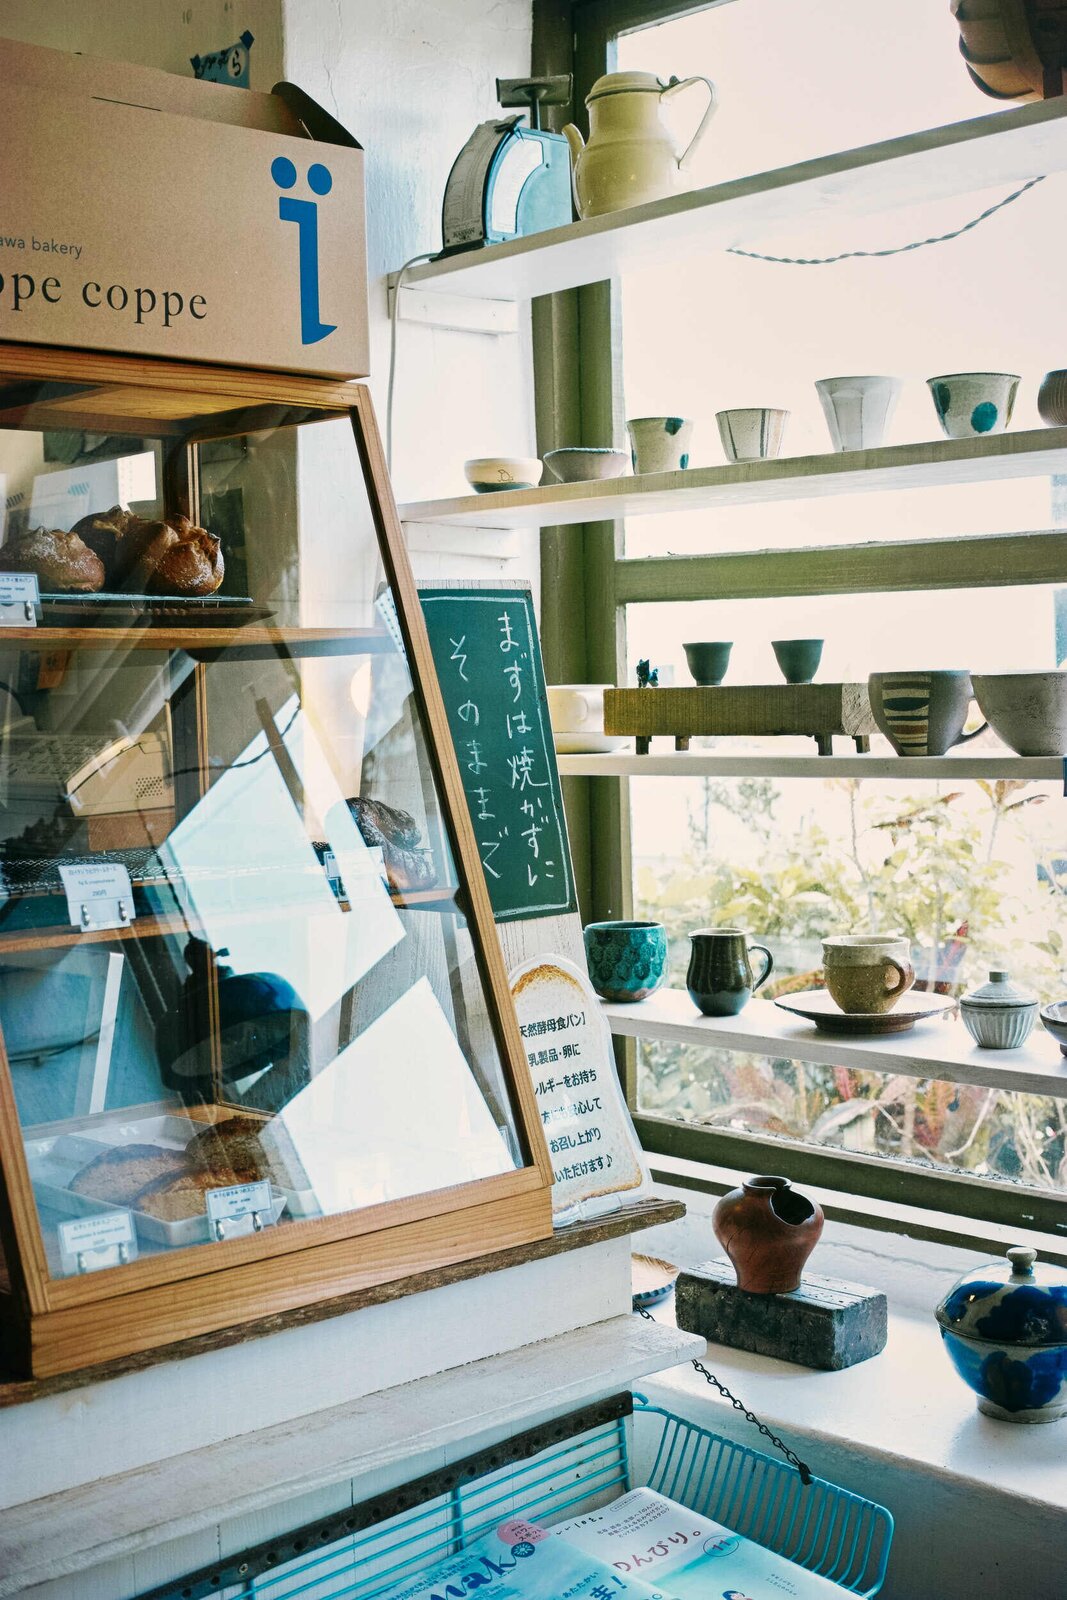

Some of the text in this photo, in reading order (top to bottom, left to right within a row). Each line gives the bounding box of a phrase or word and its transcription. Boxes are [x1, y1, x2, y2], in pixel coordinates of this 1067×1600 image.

[32, 235, 83, 260] bakery
[0, 272, 208, 328] pe coppe
[497, 611, 555, 887] まずは焼かずに
[549, 1127, 602, 1153] お召し上がり
